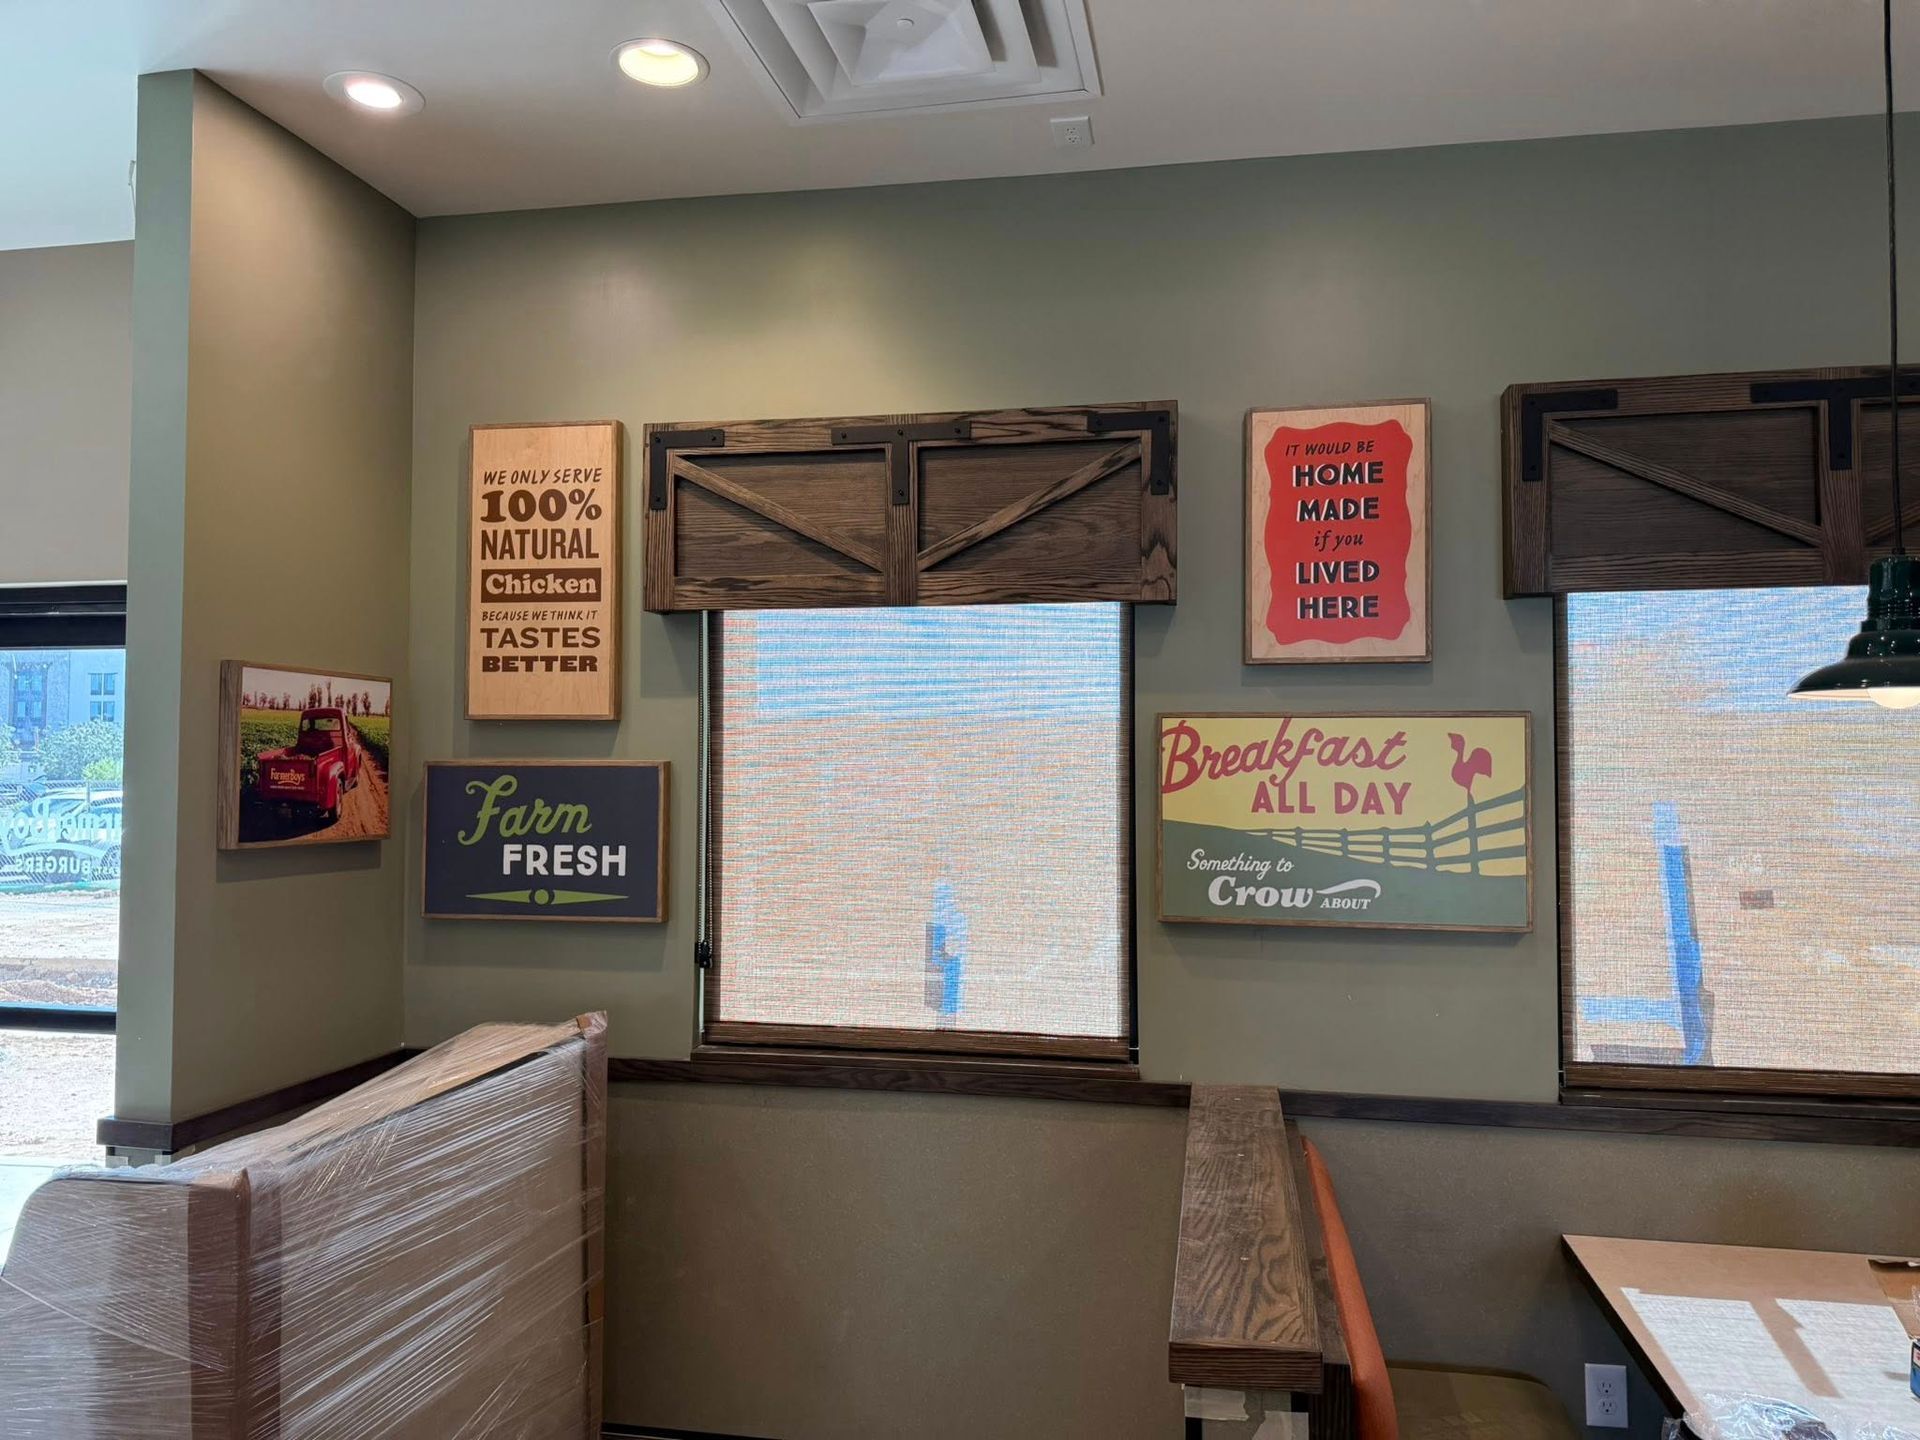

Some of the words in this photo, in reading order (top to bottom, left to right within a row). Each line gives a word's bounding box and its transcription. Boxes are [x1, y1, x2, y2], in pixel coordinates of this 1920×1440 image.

[1285, 444, 1300, 456] IT
[1305, 442, 1351, 456] WOULD
[1356, 440, 1375, 453] BE
[483, 471, 507, 485] WE
[511, 470, 550, 484] ONLY
[553, 468, 602, 483] SERVE
[1292, 461, 1383, 487] HOME
[480, 488, 602, 523] 100%
[1297, 496, 1379, 522] MADE
[481, 528, 600, 560] NATURAL
[1314, 530, 1333, 551] if
[1333, 534, 1364, 551] you
[485, 573, 597, 595] Chicken
[1296, 560, 1380, 584] LIVED
[482, 611, 528, 621] BECAUSE
[531, 611, 548, 620] WE
[550, 610, 583, 620] THINK
[586, 610, 598, 620] IT
[1297, 595, 1379, 619] HERE
[480, 627, 601, 649] TASTES
[482, 655, 598, 673] BETTER
[1161, 716, 1408, 794] Breakfast
[457, 774, 593, 846] Farm
[1251, 781, 1316, 814] ALL
[1334, 781, 1412, 815] DAY
[502, 844, 627, 876] FRESH
[1187, 848, 1271, 880] Something
[1276, 855, 1294, 872] to
[1208, 875, 1313, 908] Crow
[1320, 897, 1371, 909] ABOUT
